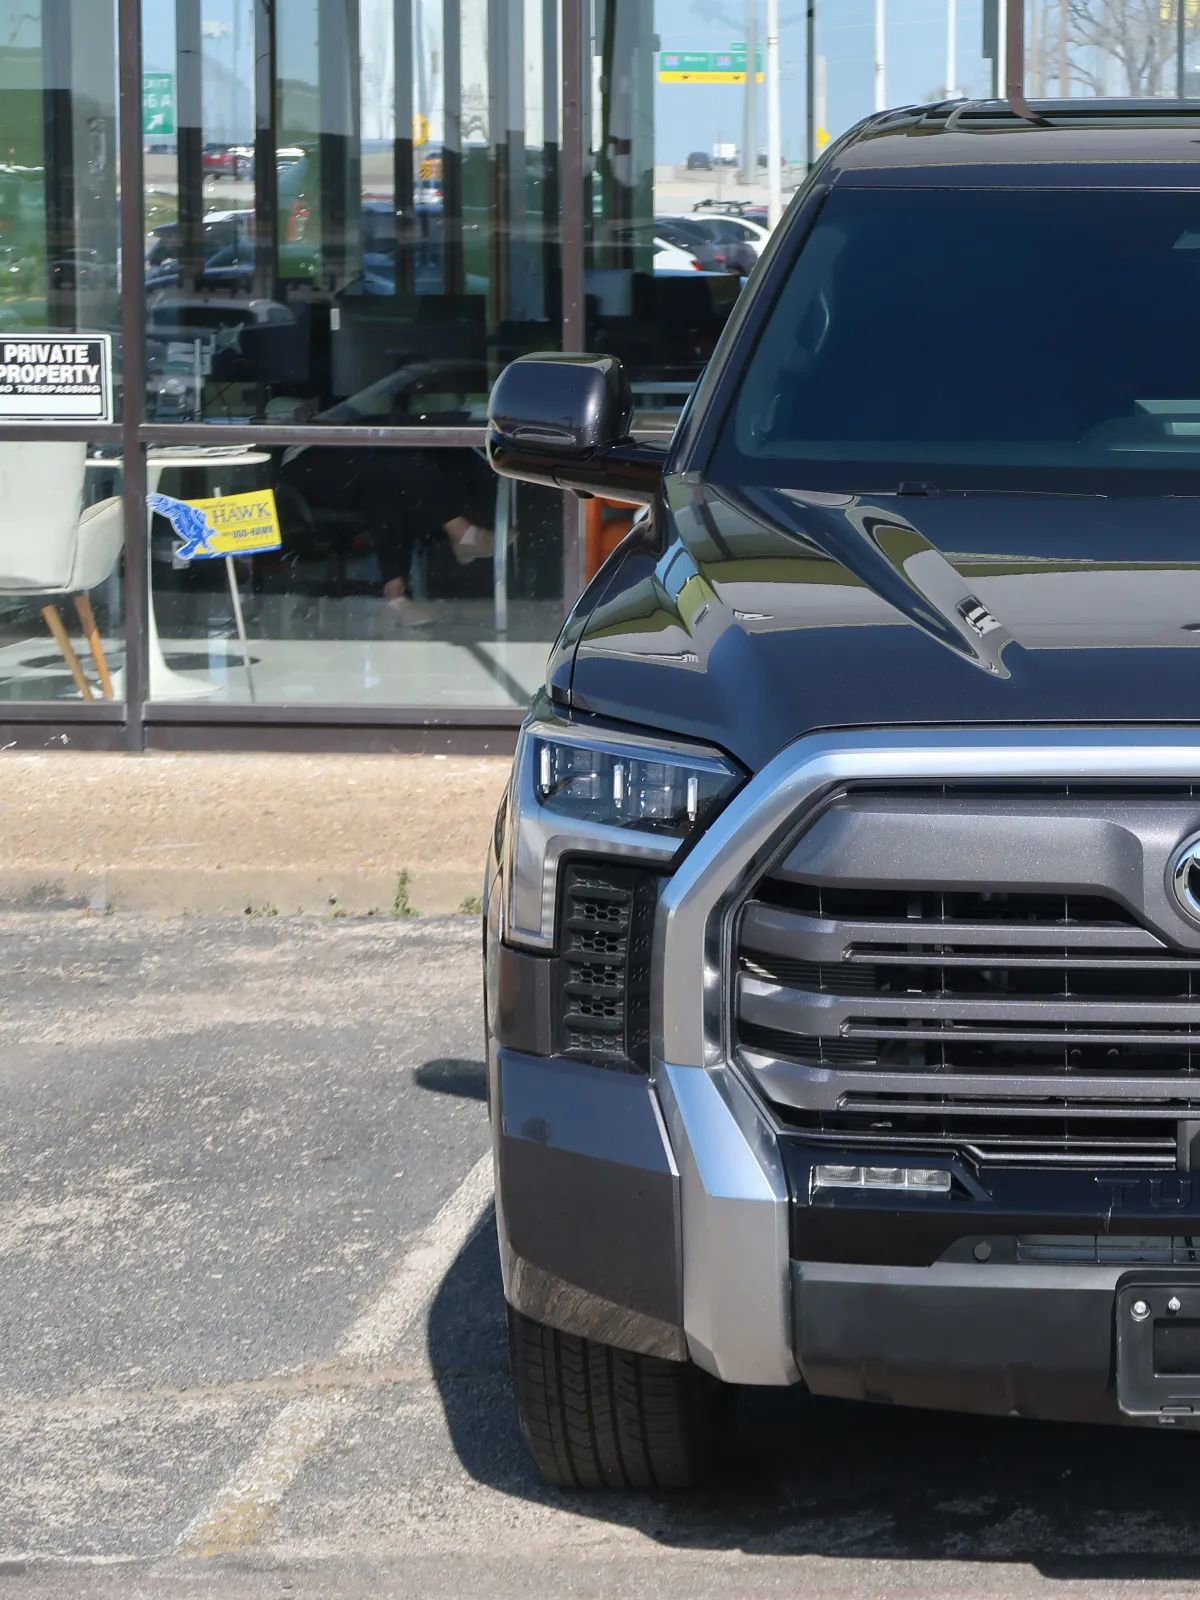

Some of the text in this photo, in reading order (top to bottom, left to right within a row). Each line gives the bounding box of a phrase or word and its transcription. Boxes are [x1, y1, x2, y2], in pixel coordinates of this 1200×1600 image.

[4, 344, 89, 363] PRIVATE
[15, 385, 101, 394] TRESPASSING
[212, 502, 272, 524] HAWK
